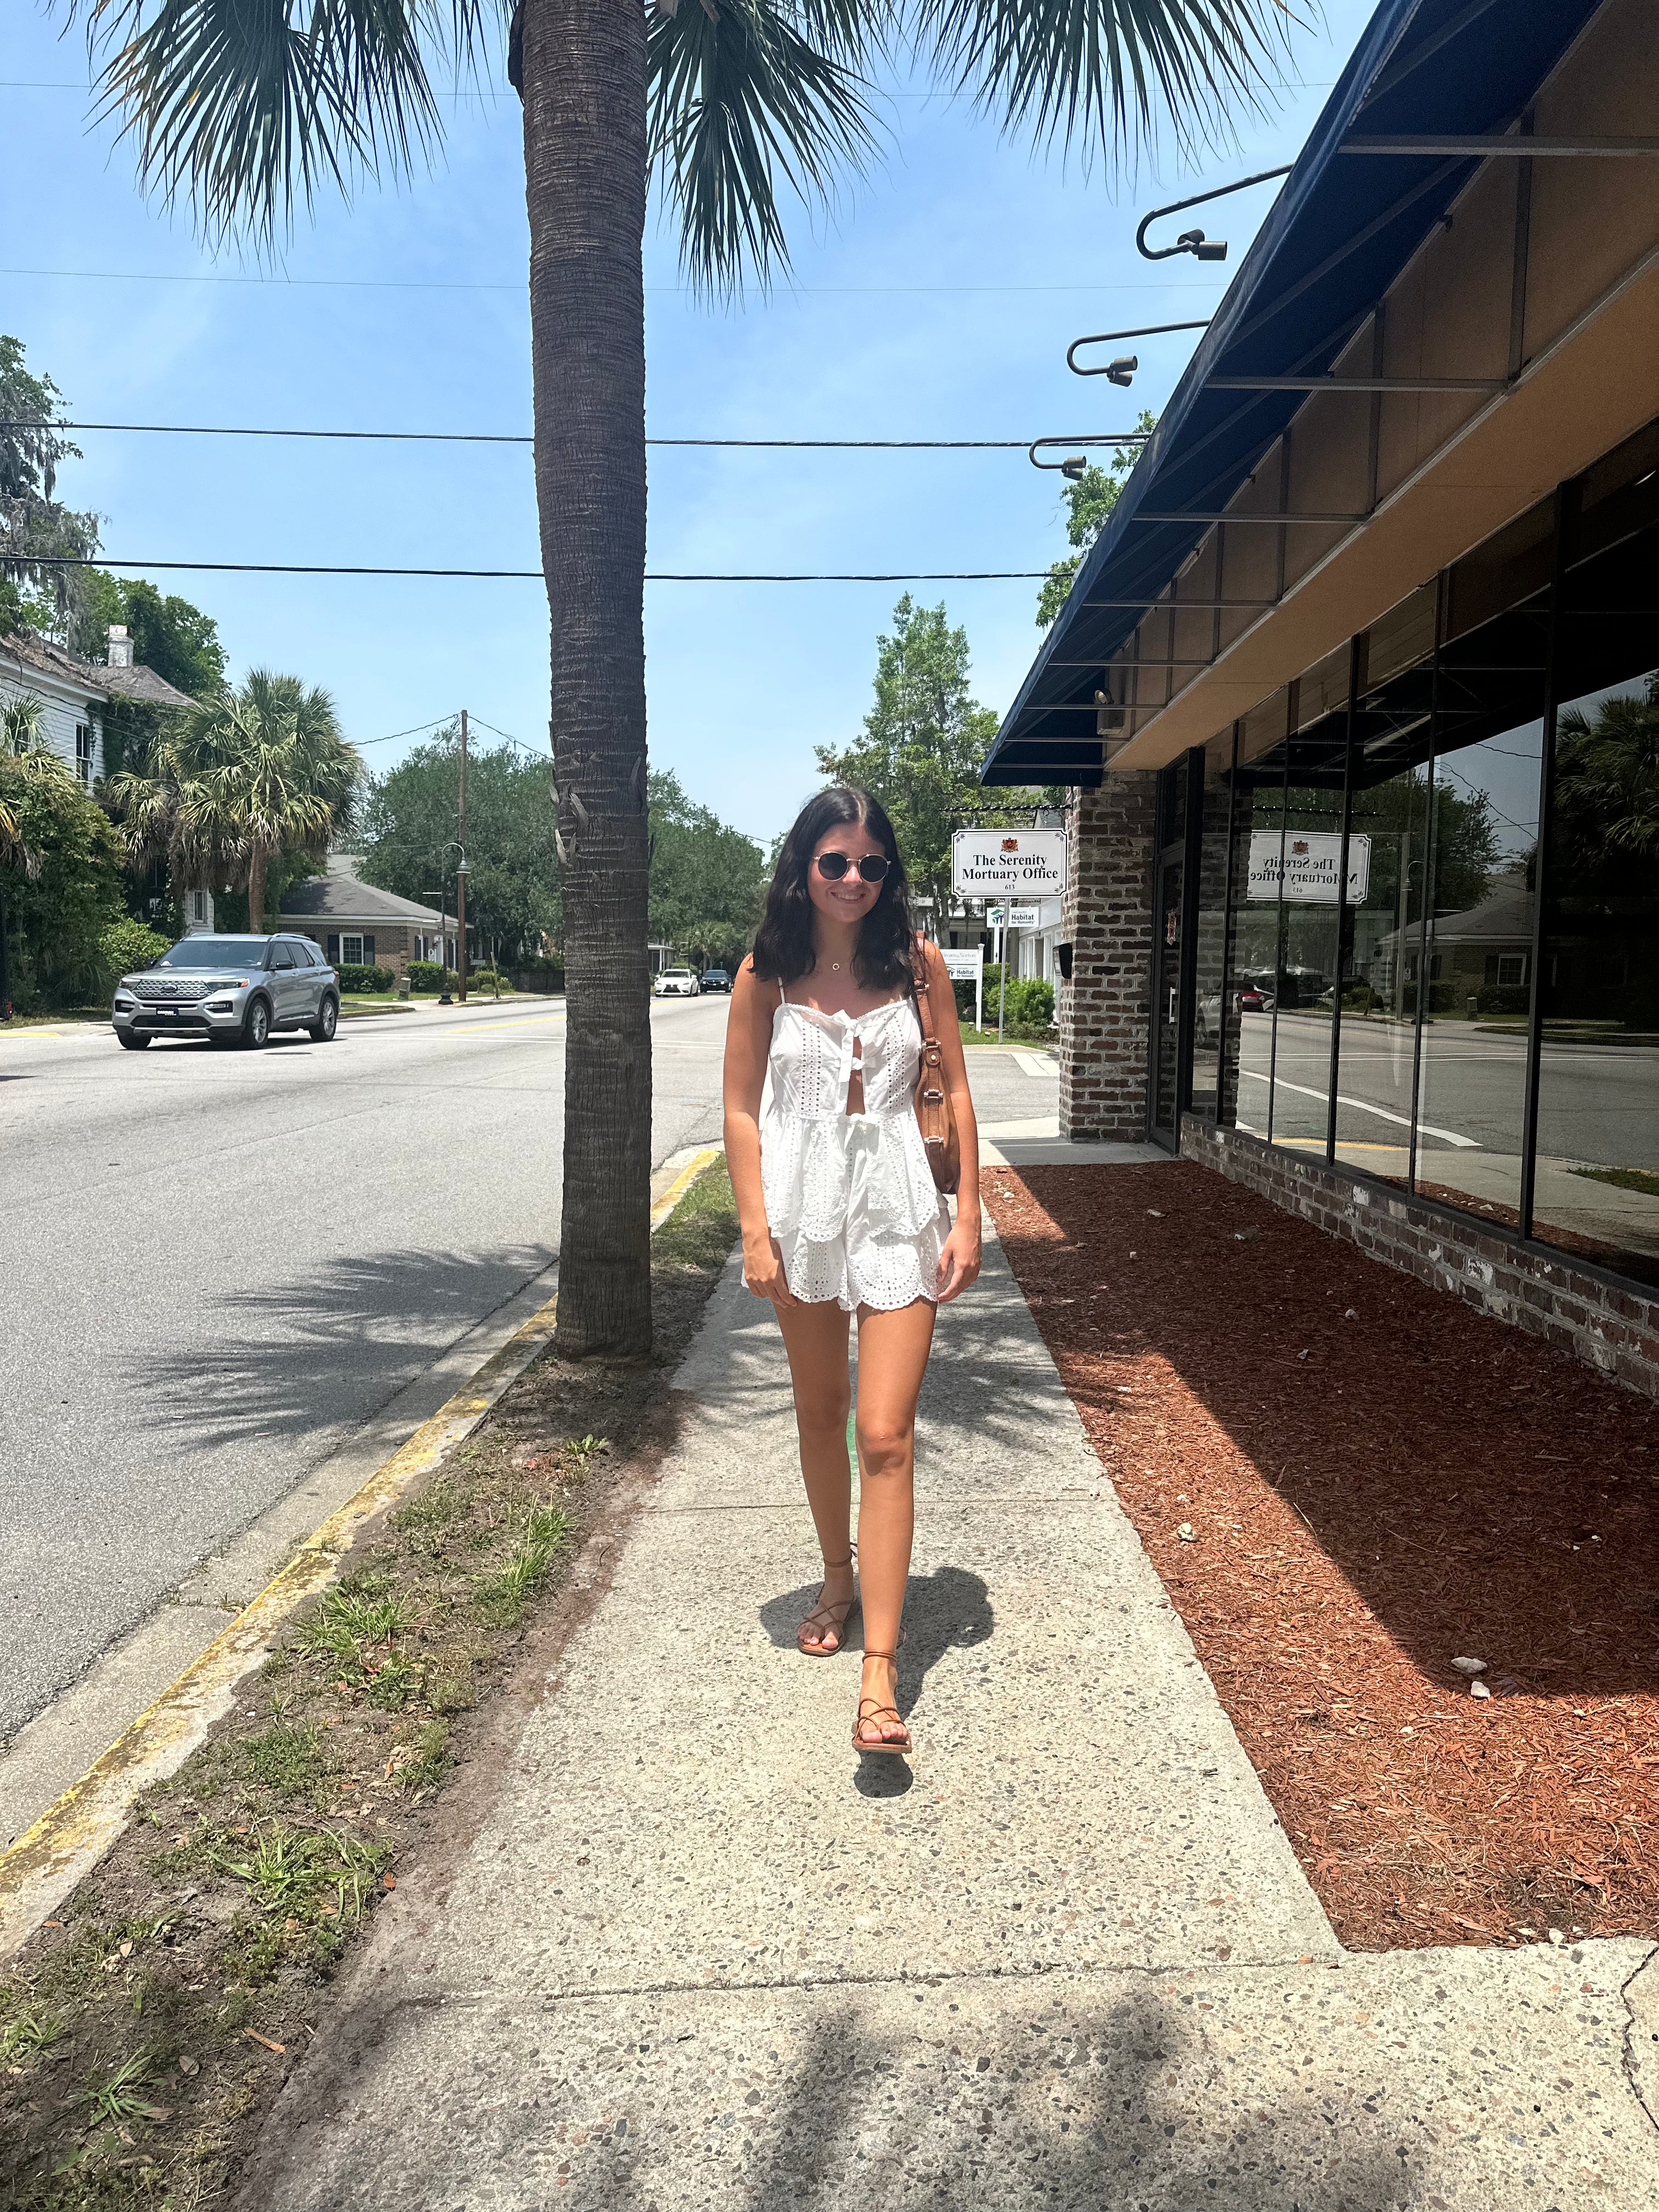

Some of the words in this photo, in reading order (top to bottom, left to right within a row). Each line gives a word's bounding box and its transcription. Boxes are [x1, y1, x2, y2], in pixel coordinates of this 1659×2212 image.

[973, 855, 995, 866] The
[999, 854, 1047, 868] Serenity
[962, 868, 1019, 882] Mortuary
[1023, 867, 1058, 879] Office
